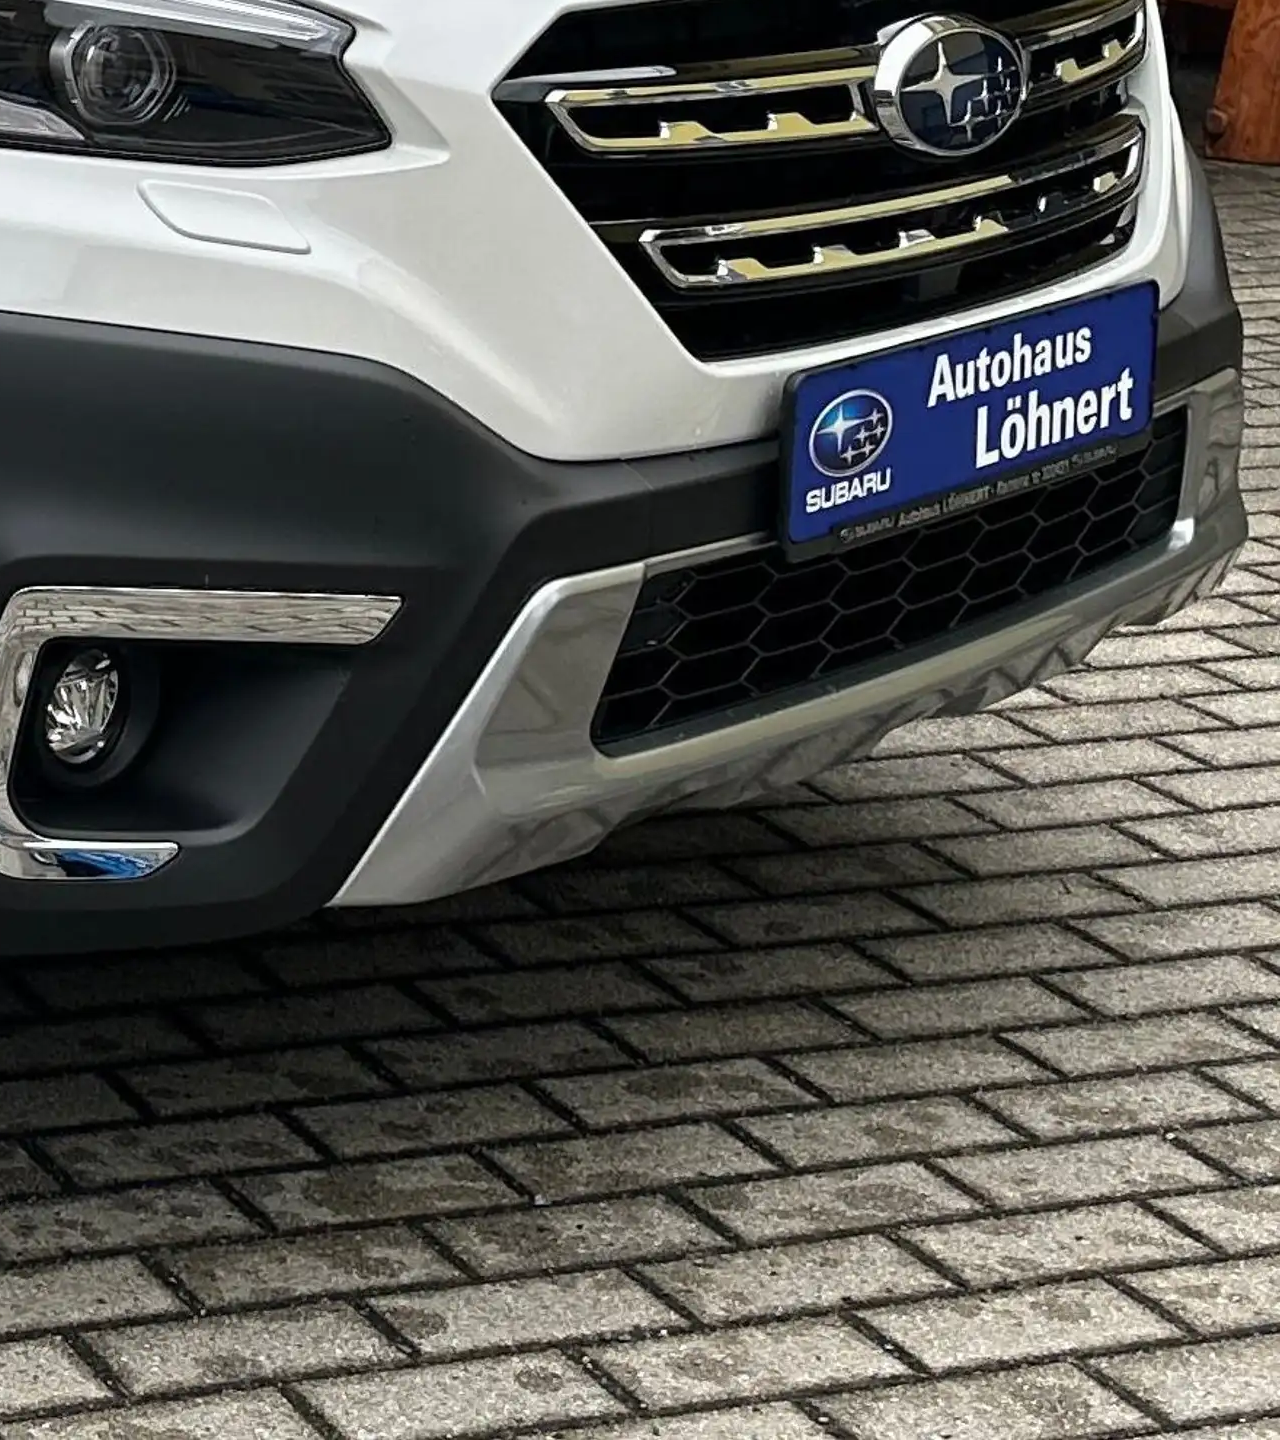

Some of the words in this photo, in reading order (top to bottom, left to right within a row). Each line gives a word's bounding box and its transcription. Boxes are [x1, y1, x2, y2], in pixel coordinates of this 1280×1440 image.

[927, 326, 1092, 408] Autohaus
[975, 366, 1133, 469] Löhnert
[806, 468, 891, 513] SUBARU
